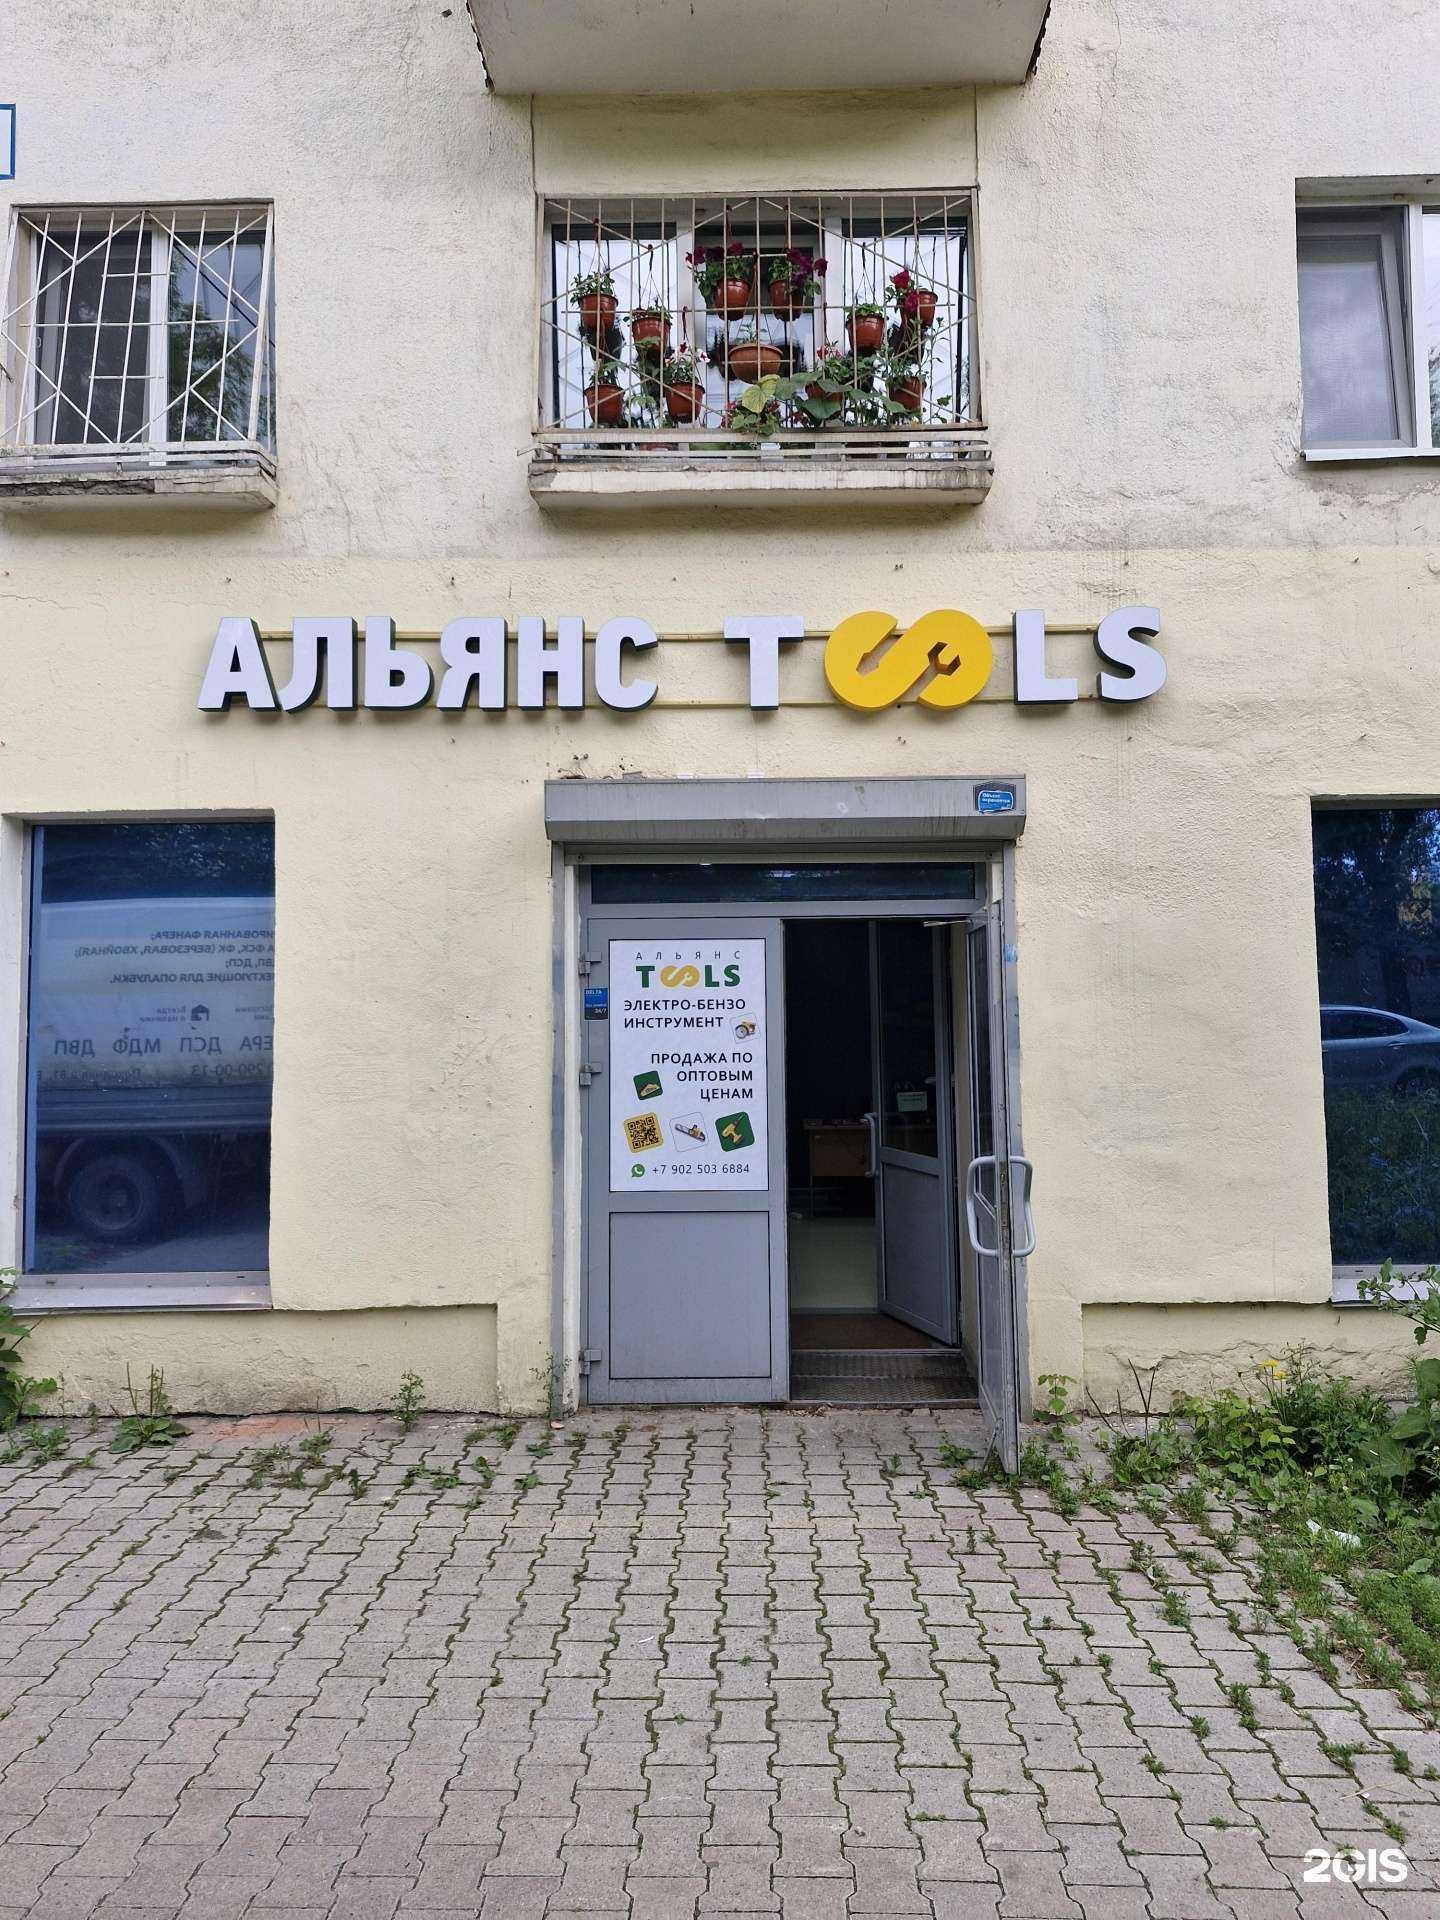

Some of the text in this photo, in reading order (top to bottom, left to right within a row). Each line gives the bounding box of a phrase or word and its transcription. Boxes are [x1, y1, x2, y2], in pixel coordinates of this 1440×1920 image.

[197, 615, 659, 713] АЛЬЯНС
[635, 950, 741, 961] АЛЬЯНС
[624, 998, 746, 1011] ЭЛЕКТРО-БЕНЗО
[624, 1017, 724, 1029] ИНСТРУМЕНТ
[651, 1052, 753, 1067] ПРОДАЖА ПО
[677, 1070, 753, 1082] ОПТОВЫМ
[700, 1088, 753, 1102] ЦЕНАМ
[652, 1163, 750, 1175] +7 902 503 6884
